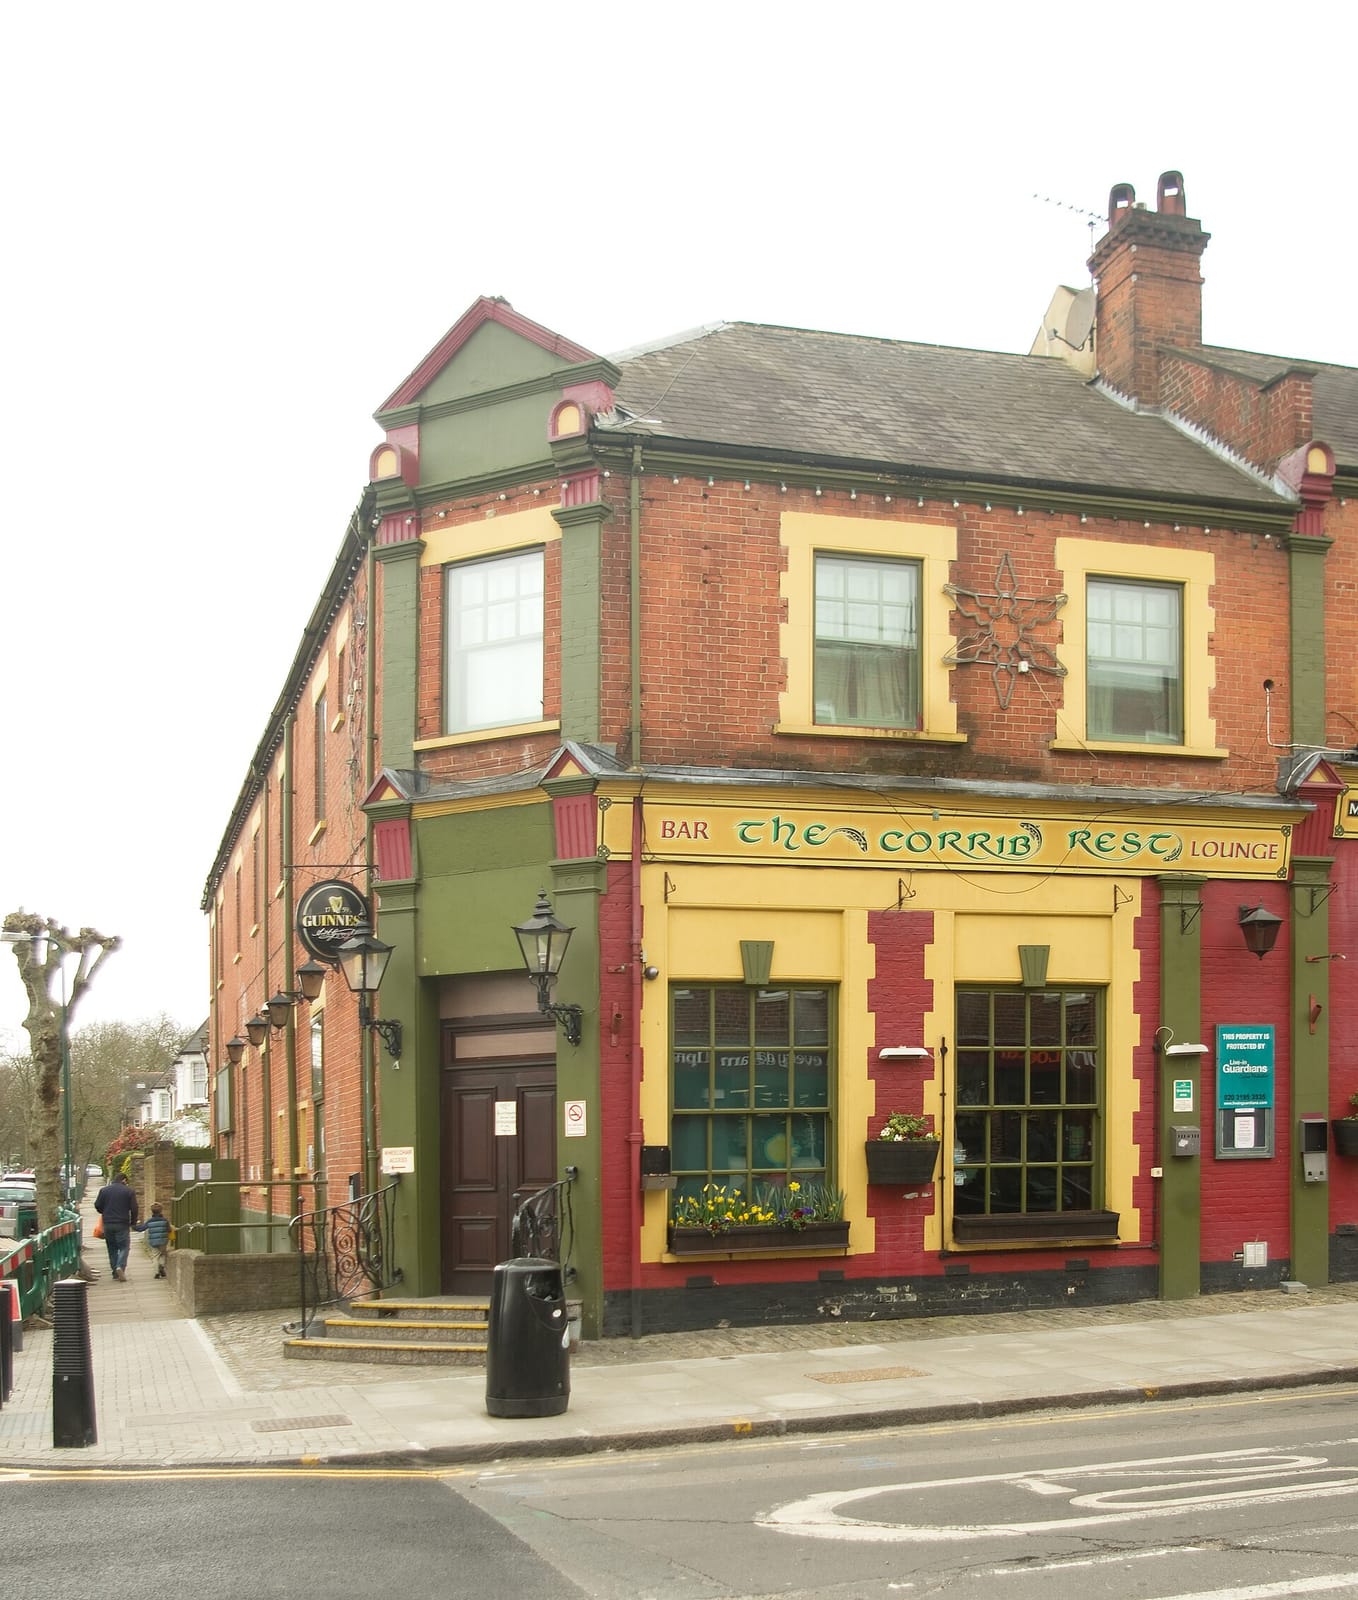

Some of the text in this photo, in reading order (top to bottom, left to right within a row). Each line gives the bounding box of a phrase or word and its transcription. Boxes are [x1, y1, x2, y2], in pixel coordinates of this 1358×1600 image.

[660, 820, 709, 840] BAR
[878, 827, 1034, 861] CORRIB
[1068, 829, 1176, 861] REST
[1190, 840, 1279, 860] LOUNGE
[302, 914, 361, 927] GUINNES
[1222, 1064, 1268, 1073] Guardians
